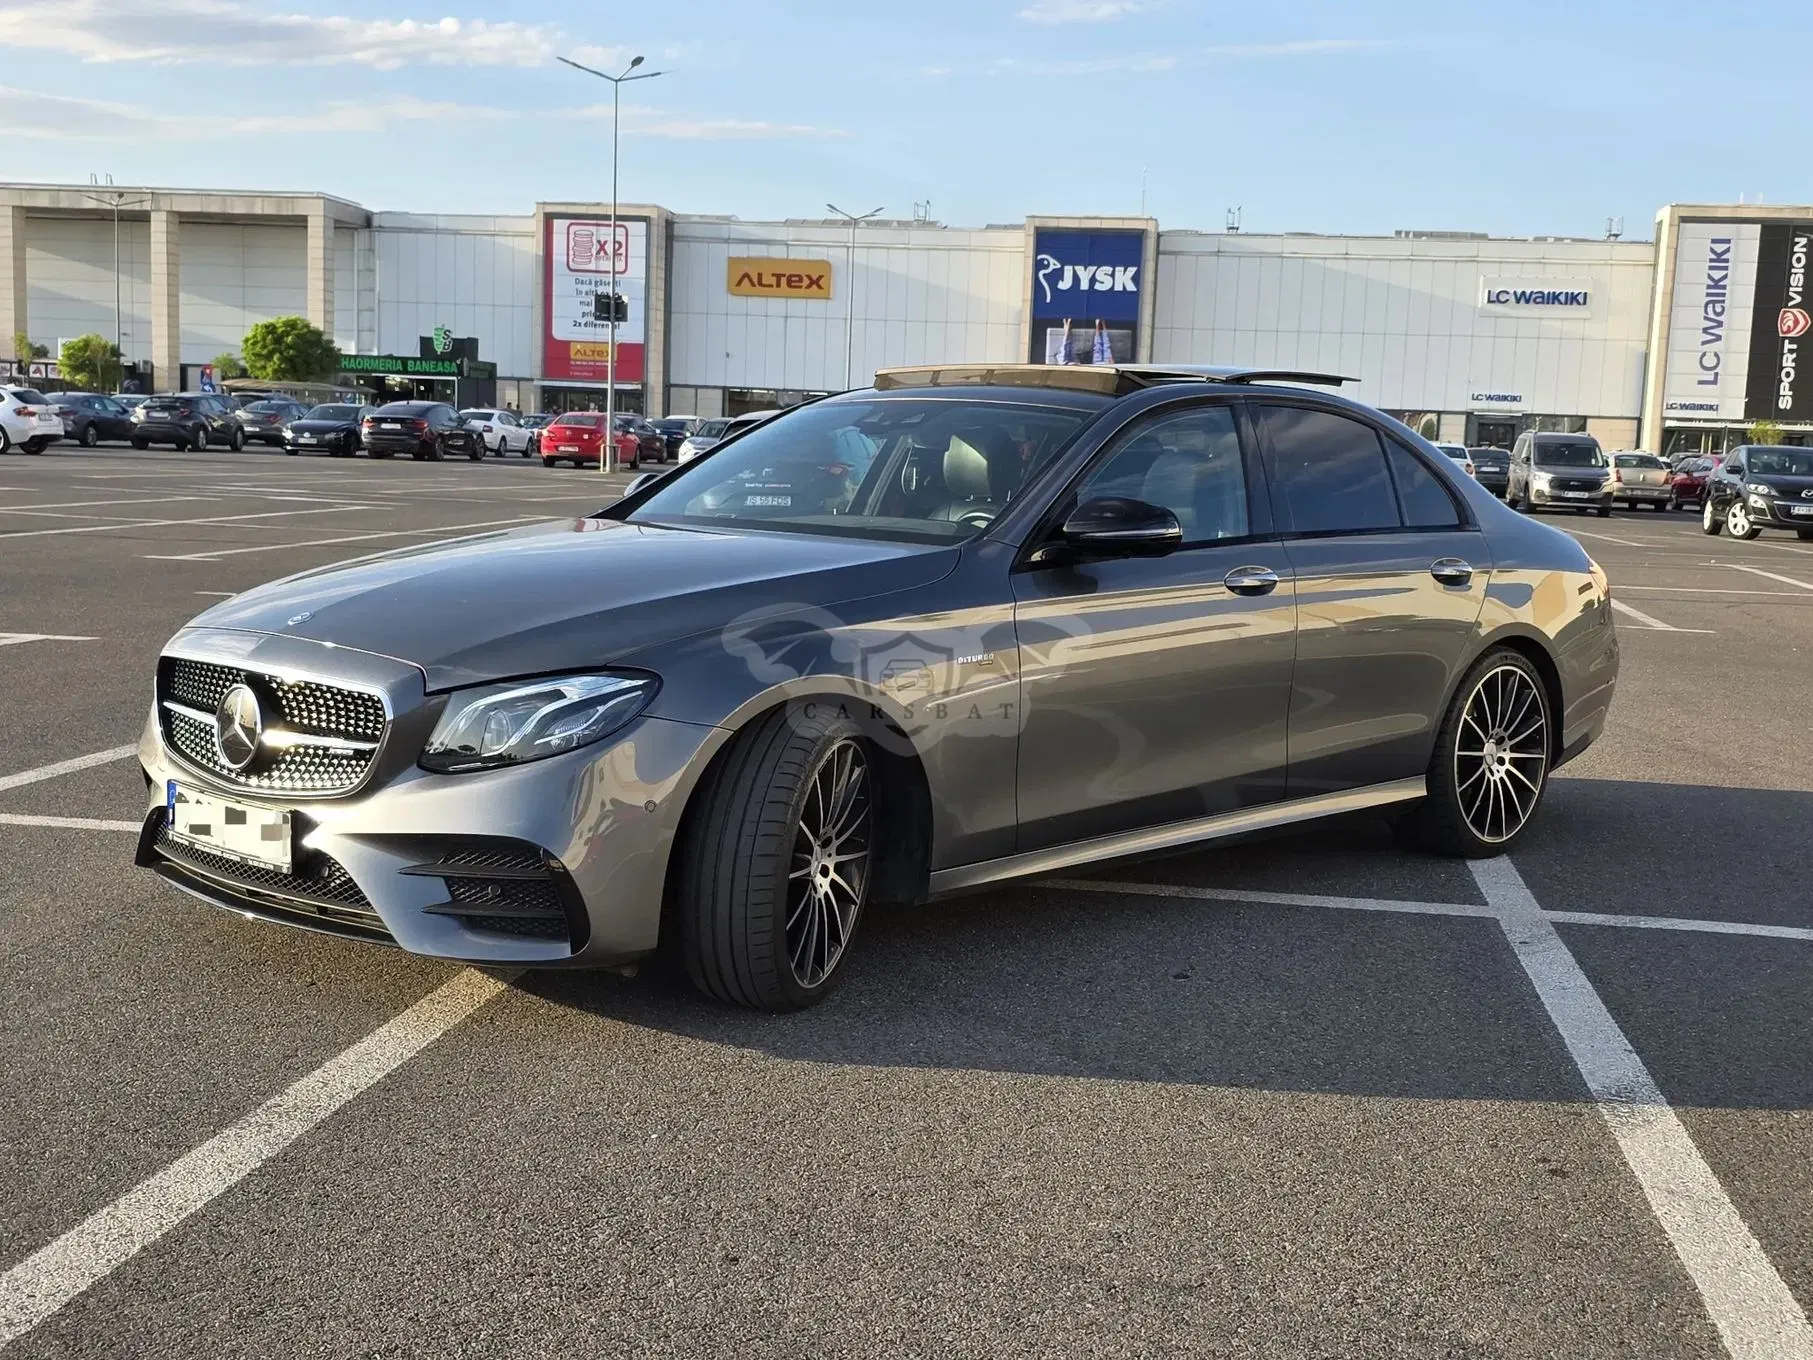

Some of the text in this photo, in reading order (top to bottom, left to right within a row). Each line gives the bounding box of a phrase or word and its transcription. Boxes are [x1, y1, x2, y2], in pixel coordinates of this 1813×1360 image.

[1057, 265, 1138, 291] JYSK
[1486, 289, 1510, 304] LC
[1778, 236, 1808, 410] SPORT VISION
[336, 357, 458, 374] HAORMERIA BANEASA
[1697, 351, 1721, 386] LC
